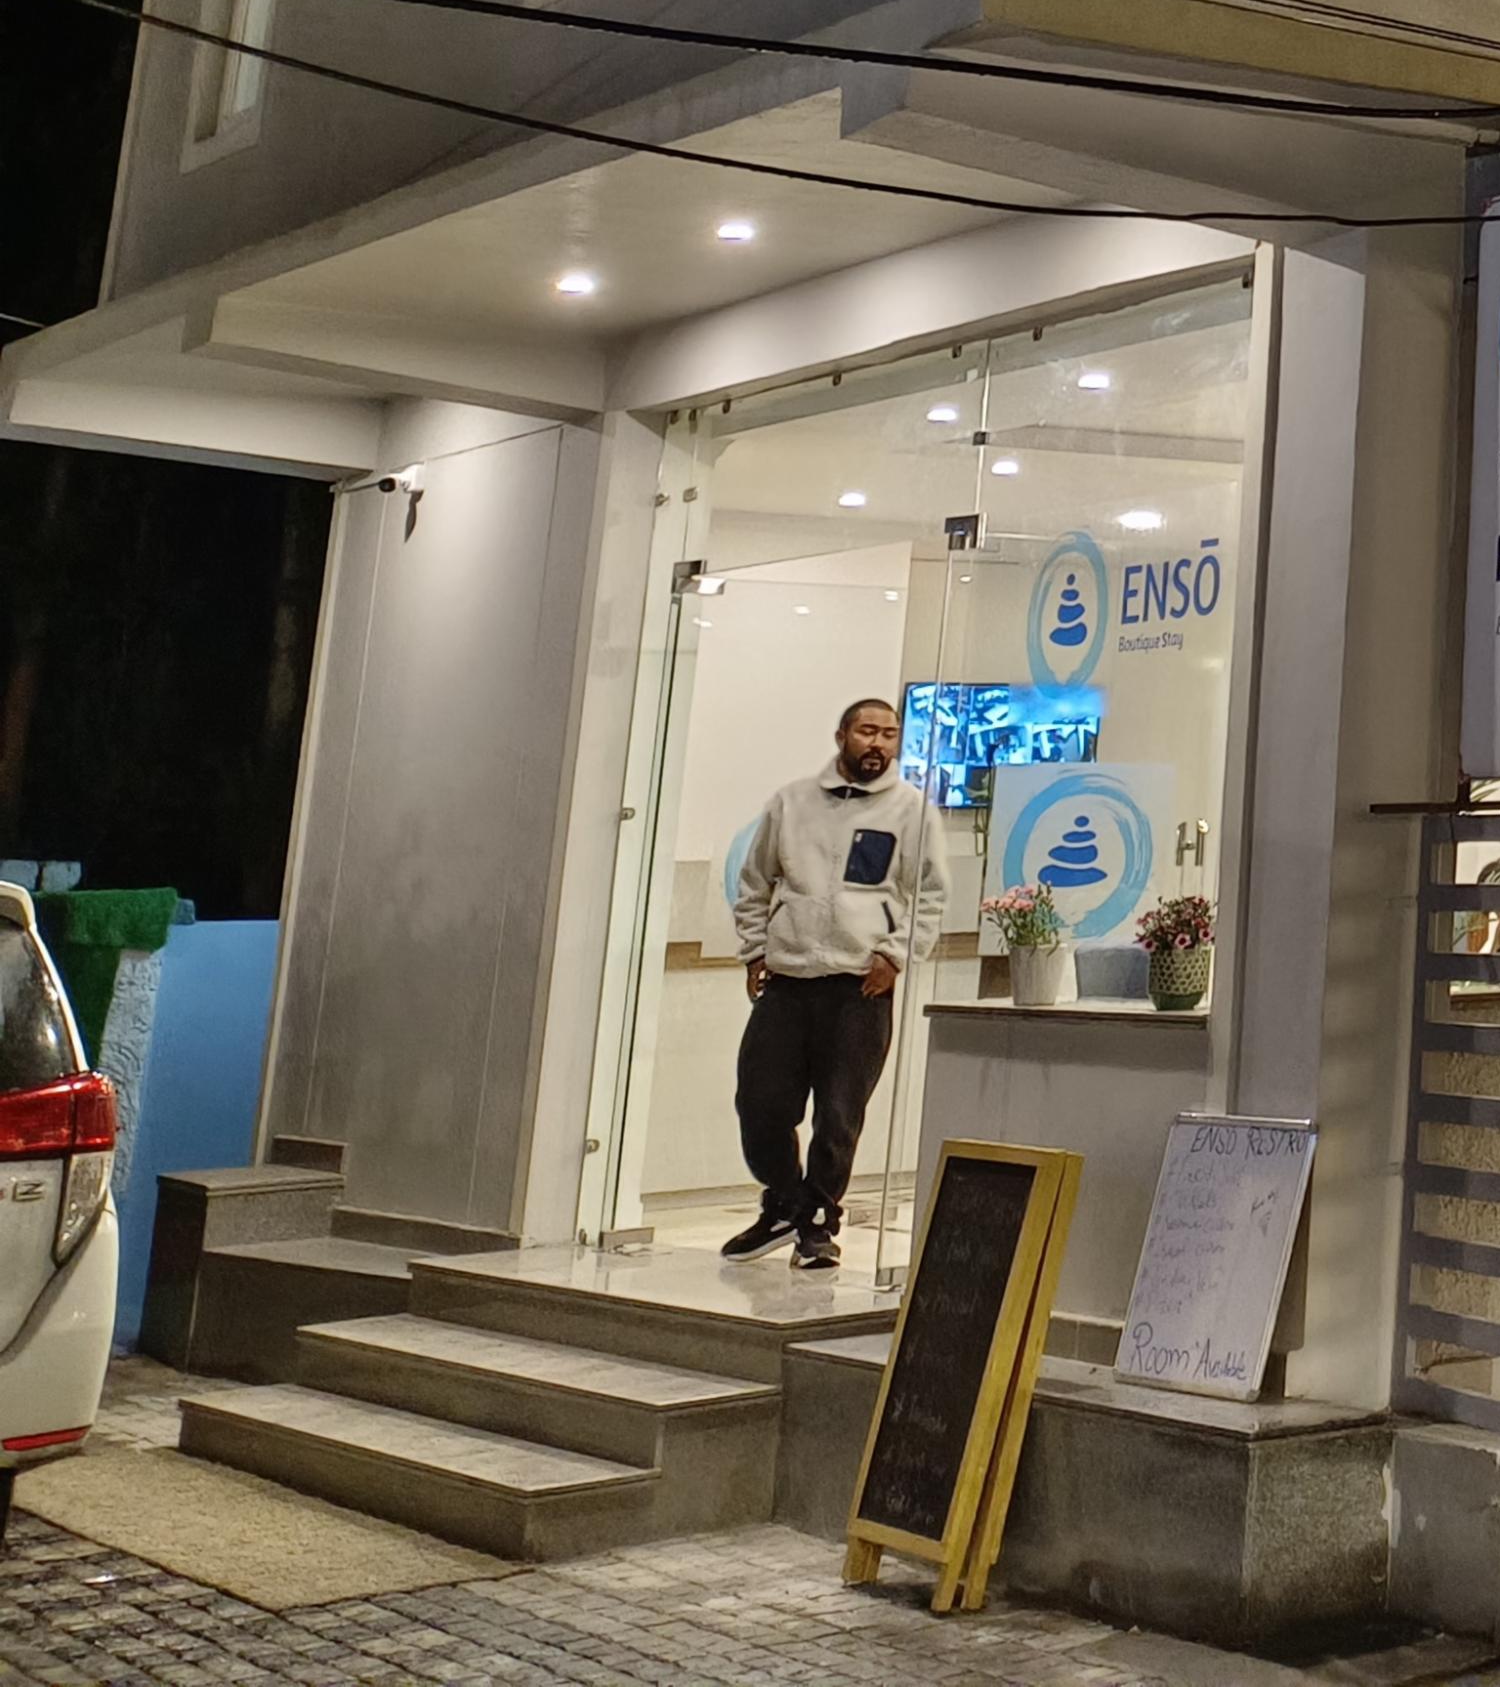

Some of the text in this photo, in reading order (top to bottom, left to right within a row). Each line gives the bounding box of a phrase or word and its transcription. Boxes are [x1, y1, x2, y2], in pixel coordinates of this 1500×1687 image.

[1121, 538, 1220, 625] ENSŌ
[1118, 631, 1184, 653] Boutique Stay
[1129, 1321, 1190, 1375] Room
